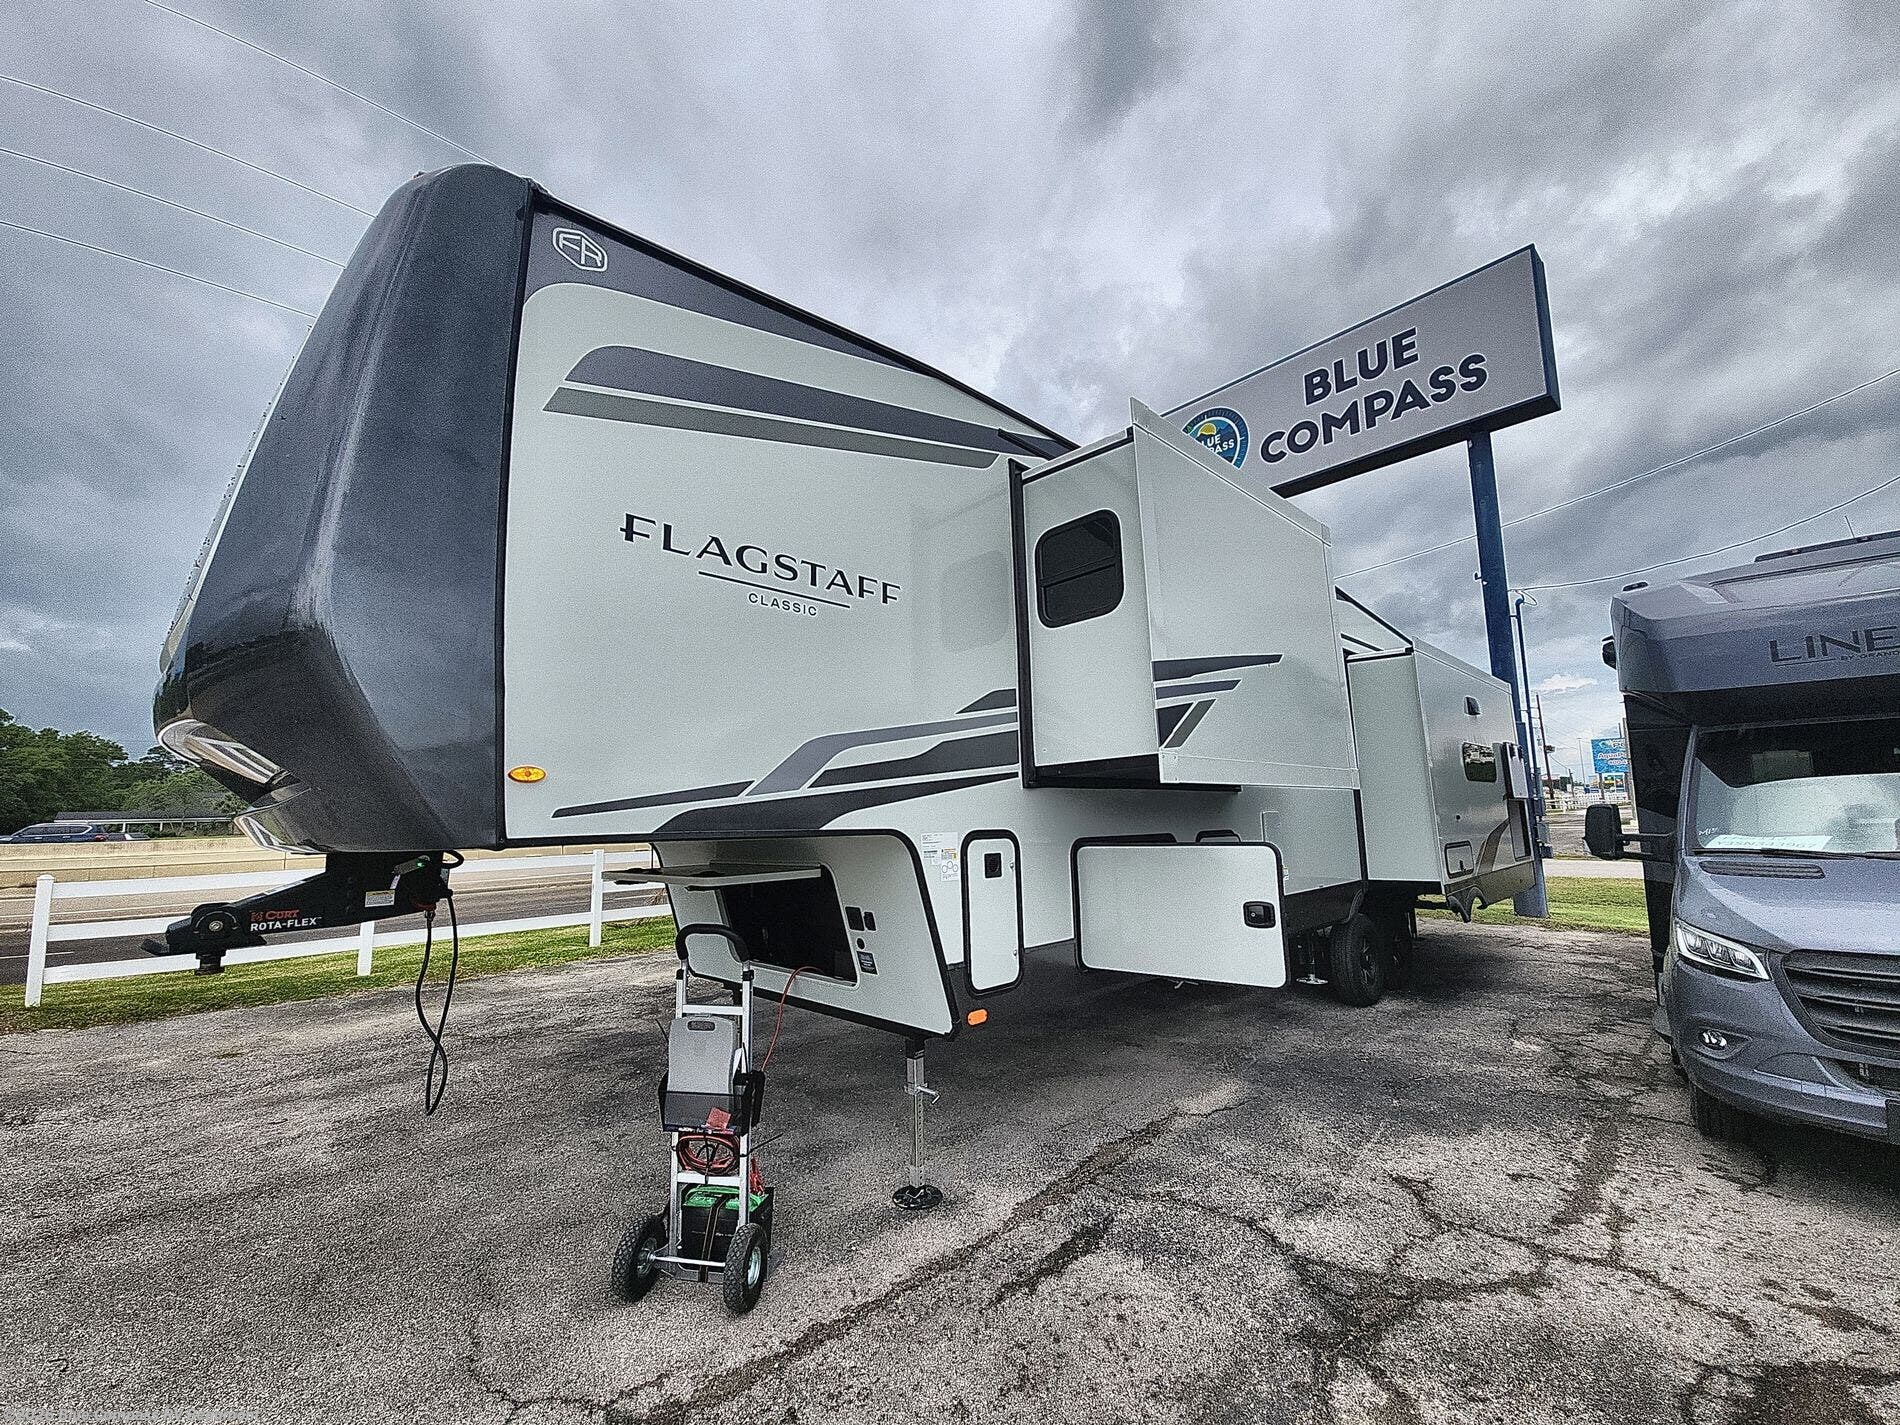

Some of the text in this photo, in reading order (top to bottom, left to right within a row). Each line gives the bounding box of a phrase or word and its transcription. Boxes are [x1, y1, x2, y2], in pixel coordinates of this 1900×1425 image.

[1303, 326, 1419, 405] BLUE
[1260, 353, 1488, 464] COMPASS
[619, 512, 901, 604] FLAGSTAFF
[748, 592, 817, 616] CLASSIC
